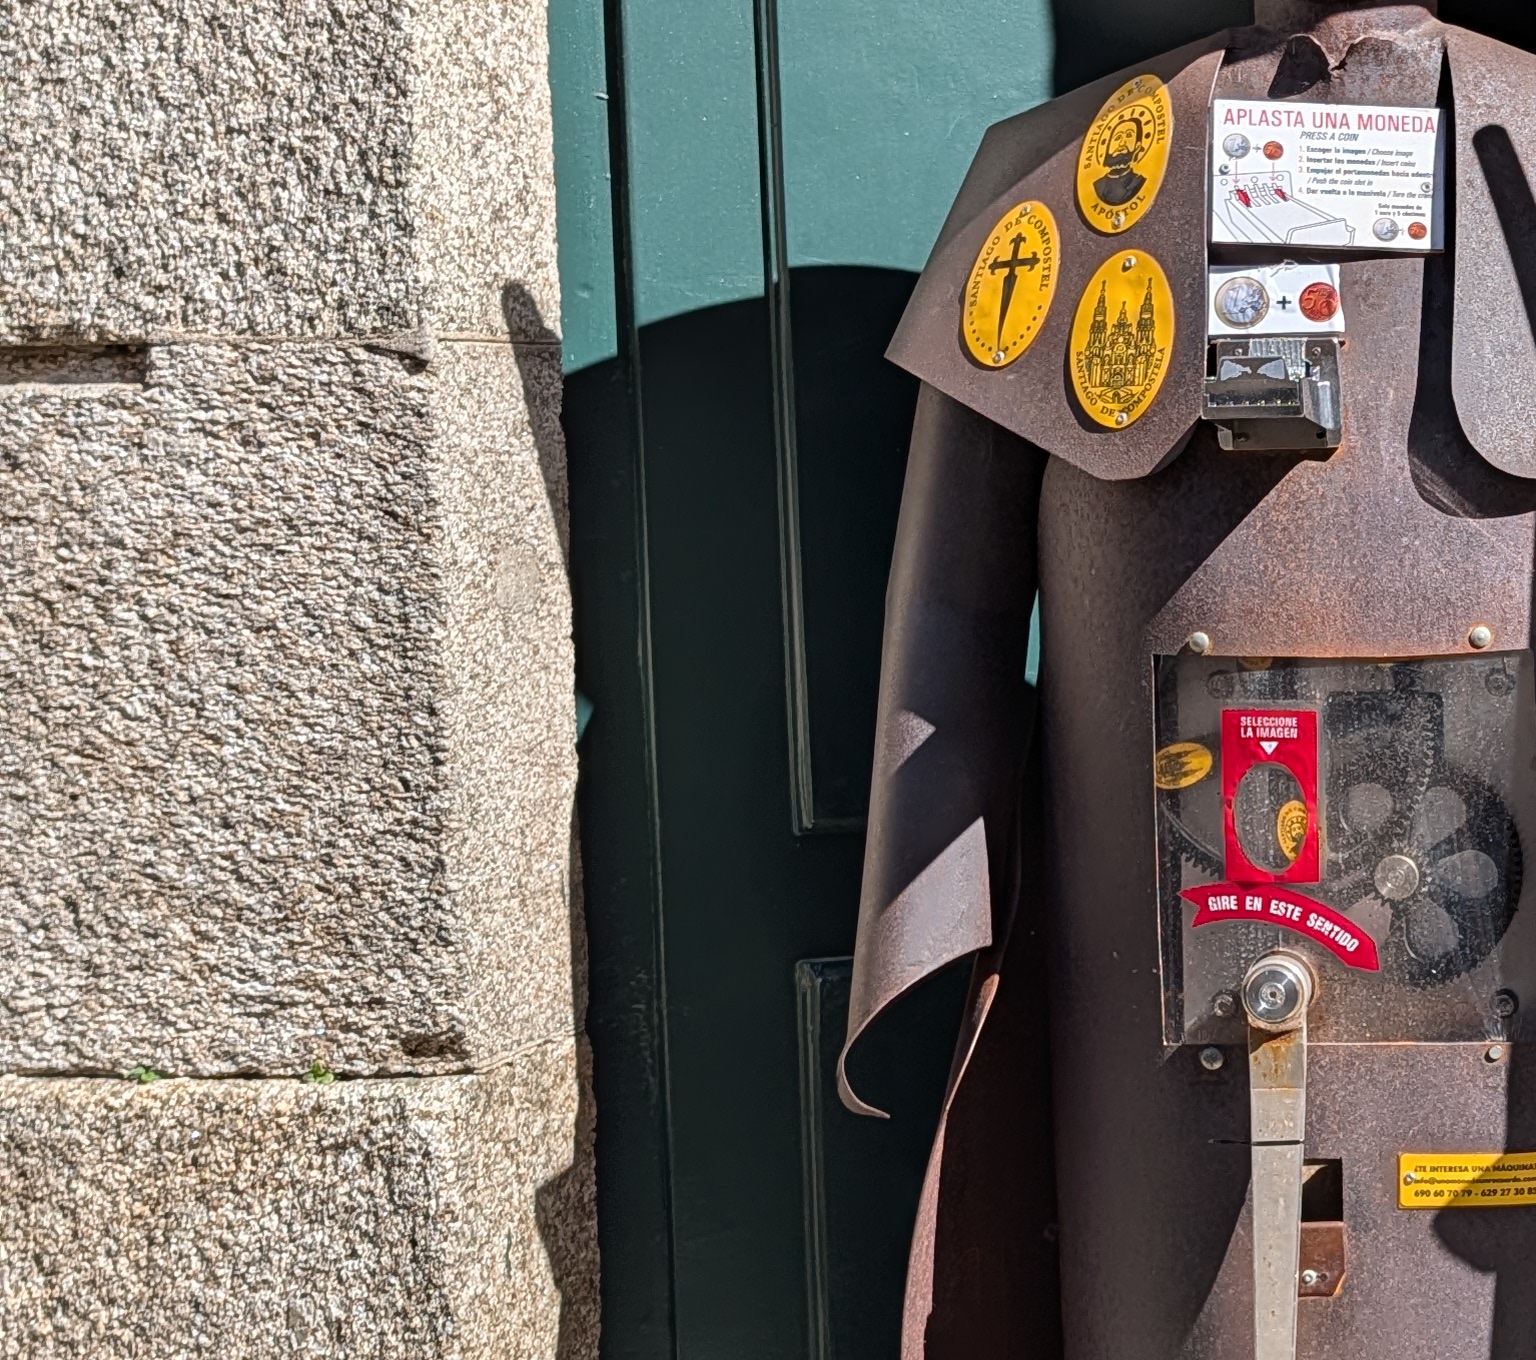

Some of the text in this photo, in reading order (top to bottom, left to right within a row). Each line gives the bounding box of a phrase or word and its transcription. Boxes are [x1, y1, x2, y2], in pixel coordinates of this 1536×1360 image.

[1223, 108, 1436, 133] APLASTA UNA MONEDA
[1083, 84, 1166, 170] SANTIAGO DE COMPOSTEL
[1299, 131, 1360, 142] PRESS A COIN
[1342, 147, 1366, 155] imagen
[1395, 149, 1414, 158] image
[969, 214, 1052, 308] SANTIAGO DE COMPOSTEL
[1076, 350, 1098, 407] SANTIAGO
[1100, 405, 1116, 418] DE
[1240, 716, 1298, 727] SELECCIONE
[1240, 727, 1298, 739] LA IMAGEN
[1208, 895, 1360, 953] GIRE EN ESTE SENTIDO
[1429, 1165, 1470, 1173] INTERESA
[1471, 1165, 1491, 1173] UNA
[1414, 1189, 1431, 1198] 690
[1433, 1189, 1445, 1198] 60
[1447, 1189, 1459, 1198] 70
[1460, 1189, 1473, 1198] 79
[1481, 1188, 1498, 1197] 629
[1500, 1188, 1512, 1197] 27
